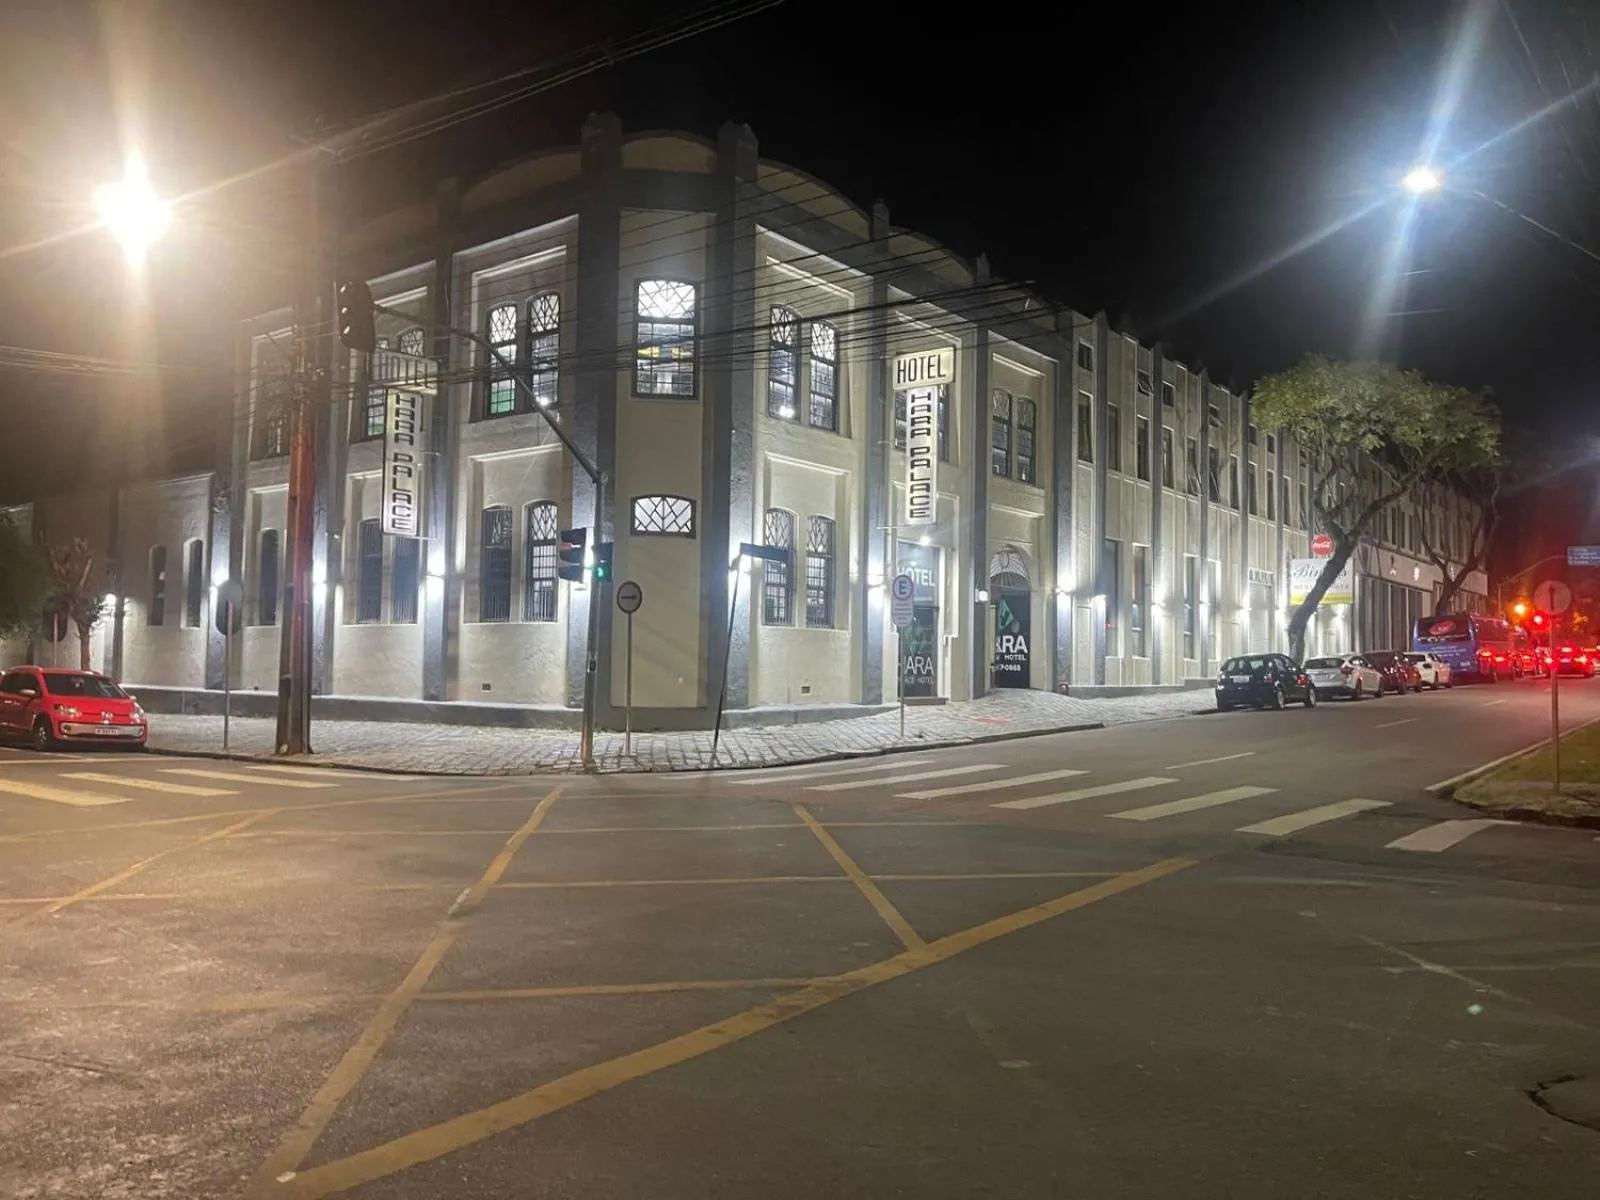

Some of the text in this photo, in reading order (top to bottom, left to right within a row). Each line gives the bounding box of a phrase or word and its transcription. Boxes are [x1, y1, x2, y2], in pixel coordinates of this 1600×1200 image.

[897, 354, 946, 384] HOTEL
[392, 392, 415, 530] HARA PALACE
[909, 392, 931, 518] HARA PALACE
[899, 580, 908, 595] E
[903, 656, 934, 675] ARA
